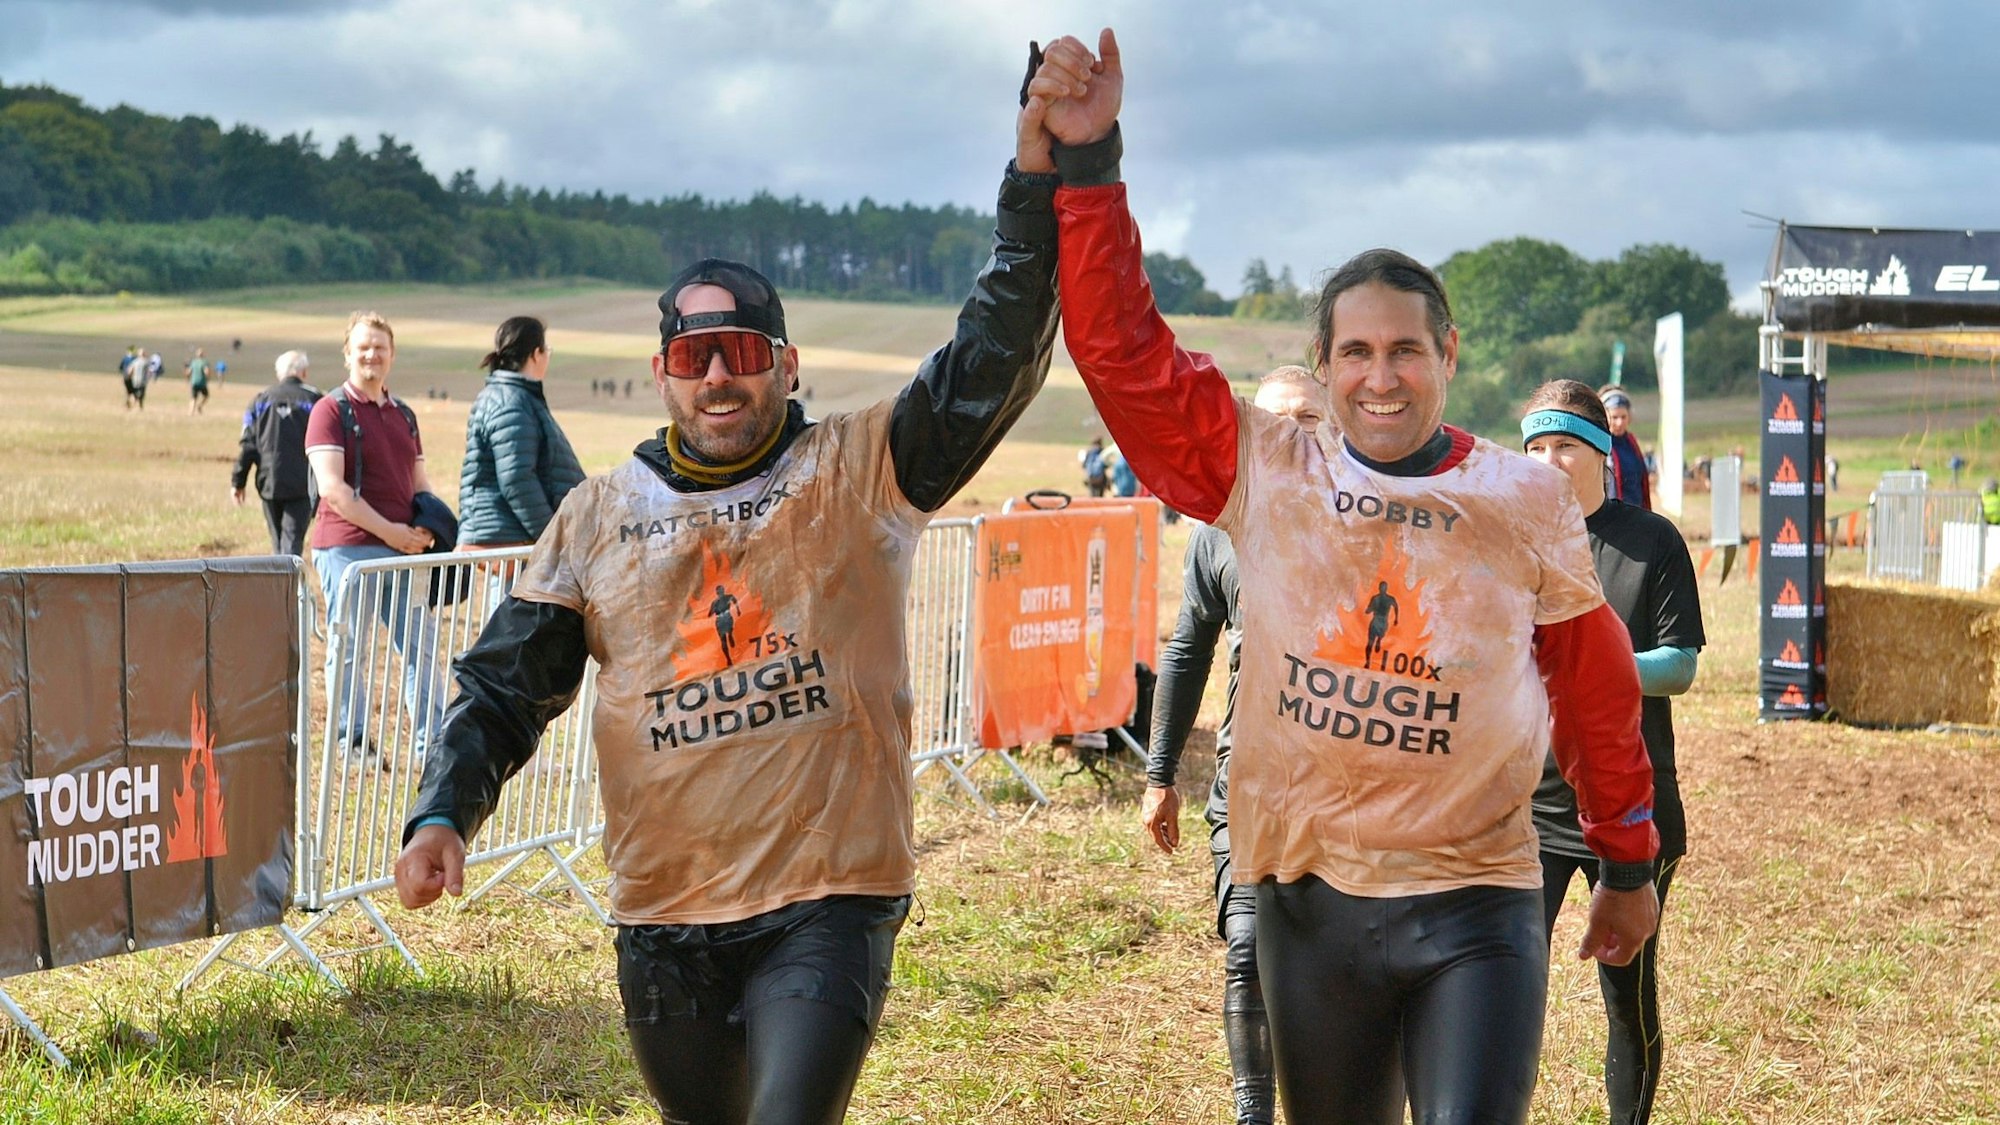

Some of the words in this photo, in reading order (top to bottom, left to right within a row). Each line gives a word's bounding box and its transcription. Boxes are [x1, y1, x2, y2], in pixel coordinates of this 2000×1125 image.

[1783, 267, 1869, 283] TOUGH
[1783, 281, 1868, 297] MUDDER
[620, 482, 793, 543] MATCHBOX
[1335, 491, 1462, 532] DOBBY
[1020, 586, 1051, 614] DIRTY
[749, 632, 799, 658] 75x
[1380, 650, 1443, 681] 100x
[644, 649, 826, 718] TOUGH
[1284, 653, 1461, 723] TOUGH
[650, 684, 830, 752] MUDDER
[1277, 690, 1452, 755] MUDDER
[24, 764, 160, 828] TOUGH
[27, 823, 161, 885] MUDDER
